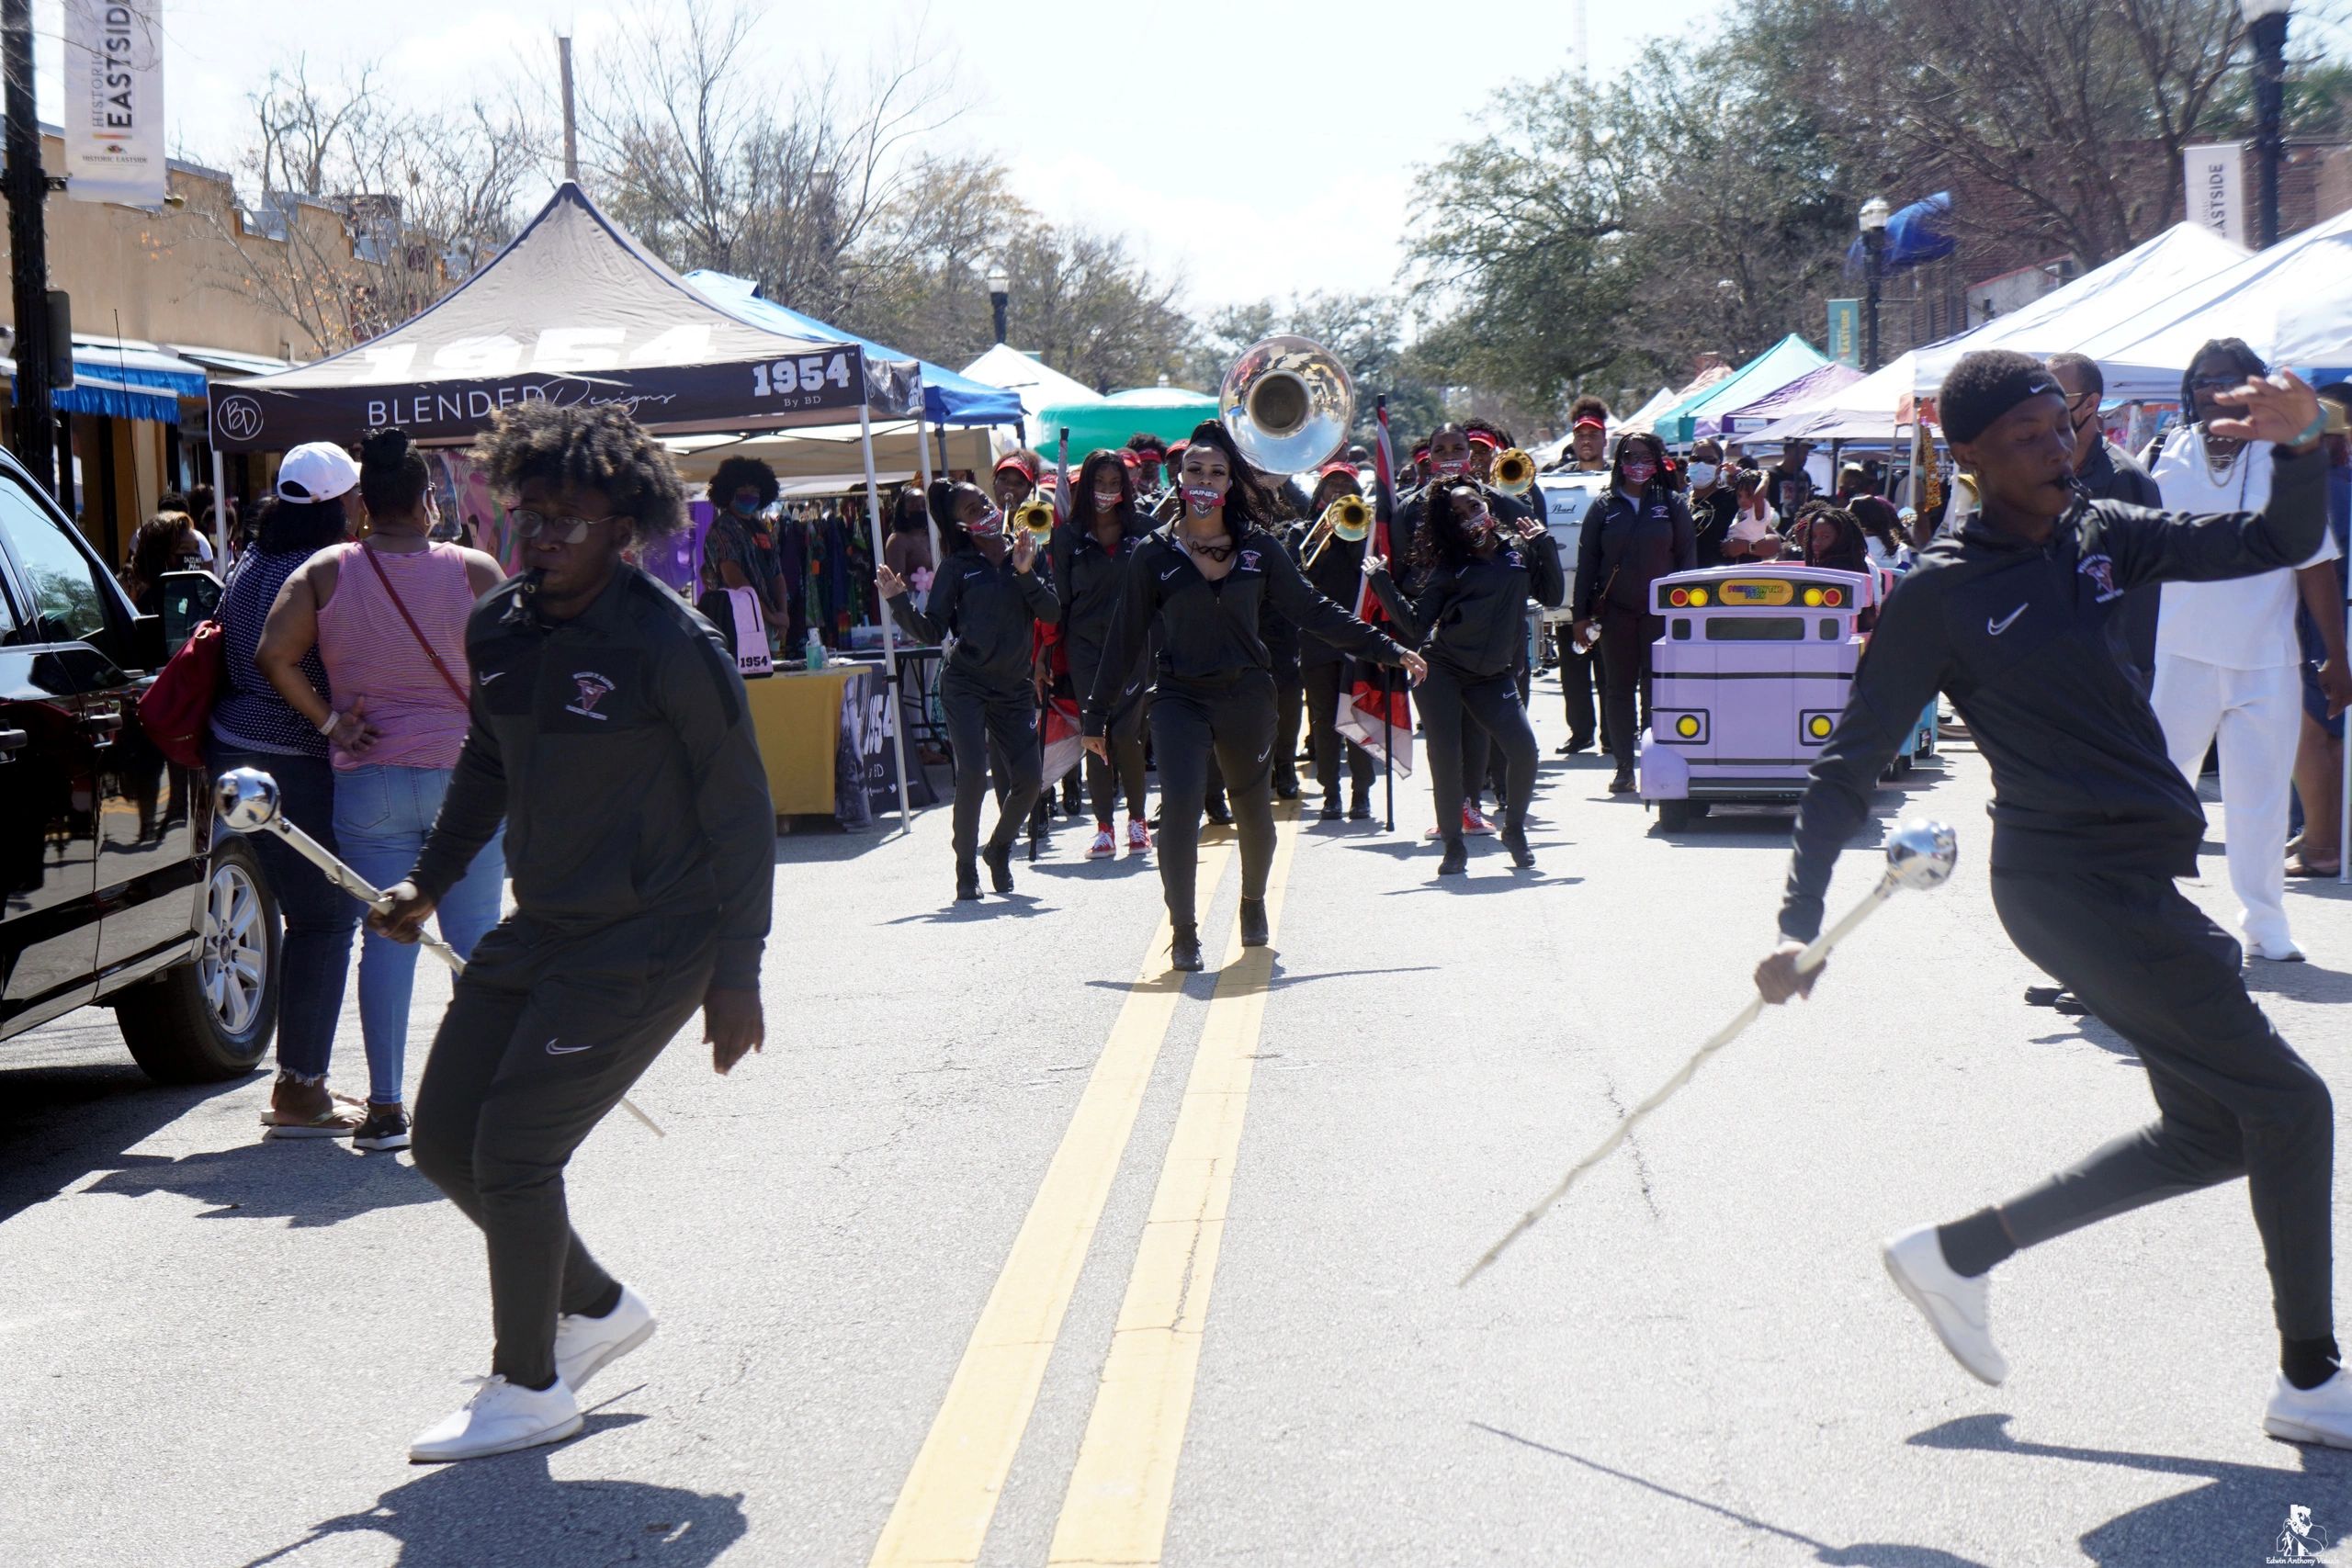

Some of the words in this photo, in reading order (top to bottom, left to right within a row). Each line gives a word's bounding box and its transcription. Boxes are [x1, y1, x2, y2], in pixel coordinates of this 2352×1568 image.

[106, 0, 132, 128] EASTSID
[91, 50, 104, 127] HISTORIC
[2209, 164, 2227, 238] ASTSIDE
[752, 353, 851, 397] 1954
[369, 386, 547, 426] BLENDED
[784, 398, 798, 408] By
[805, 396, 821, 405] BD
[1189, 490, 1219, 499] RAINES
[1550, 503, 1577, 513] Pearl
[741, 655, 768, 668] 1954
